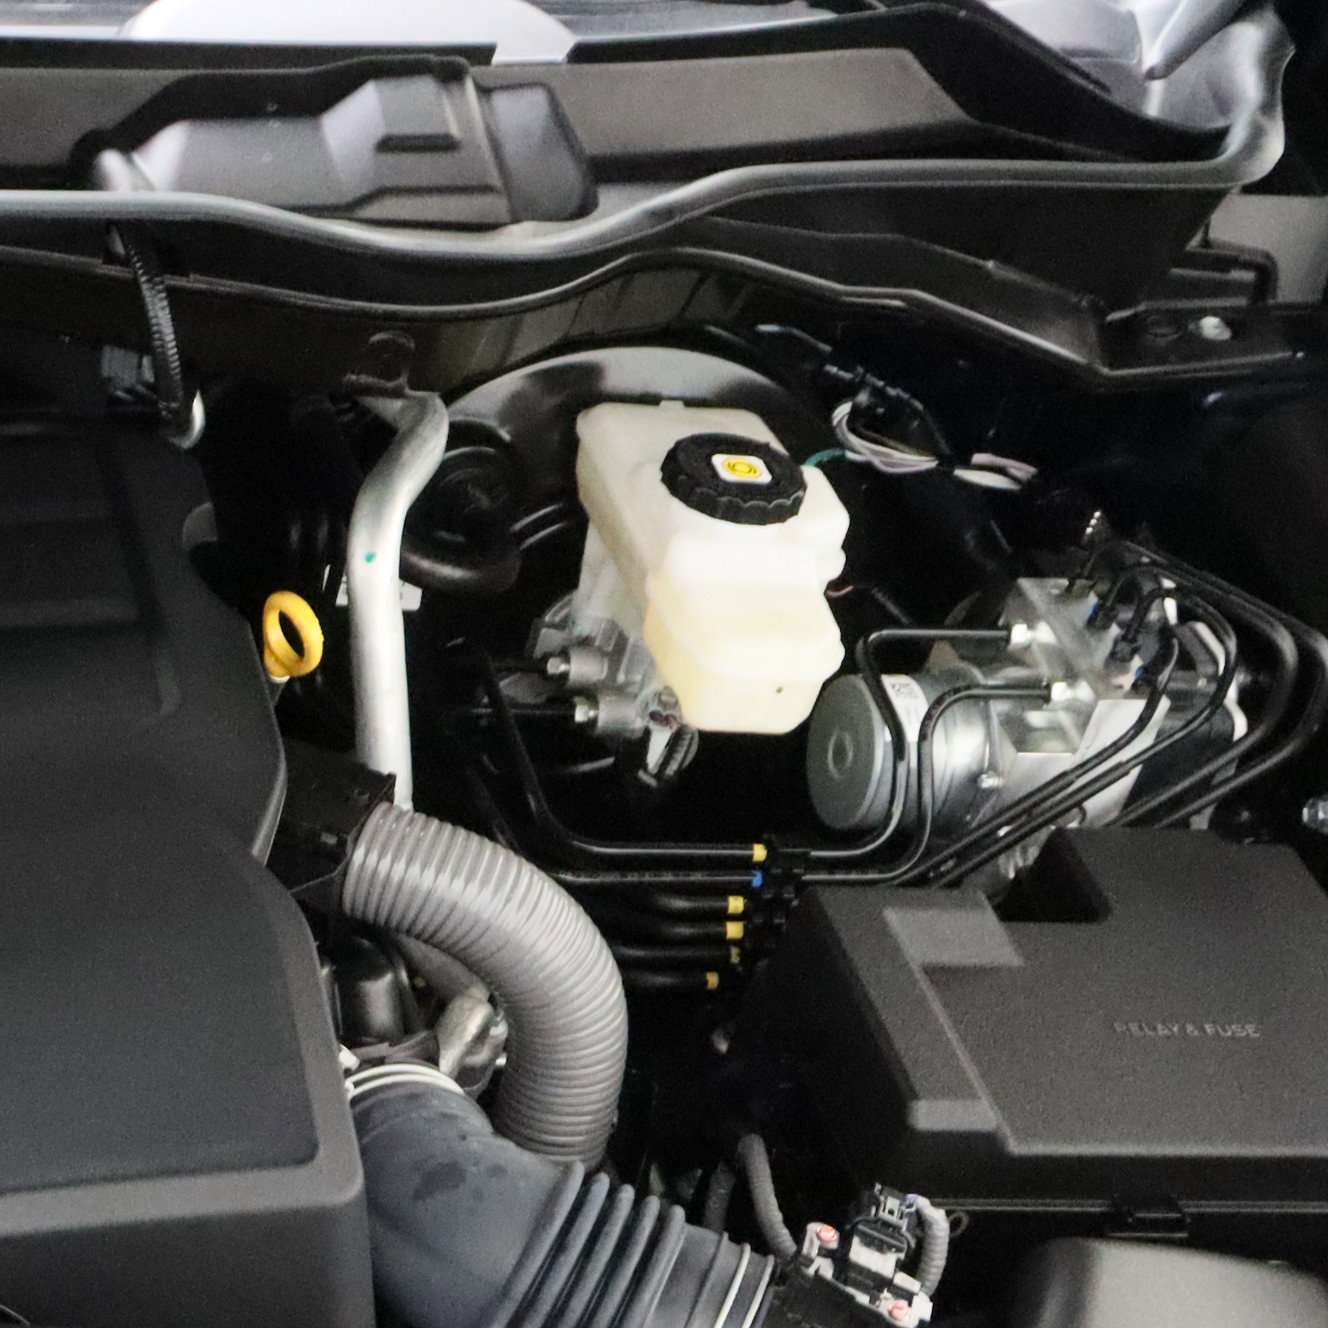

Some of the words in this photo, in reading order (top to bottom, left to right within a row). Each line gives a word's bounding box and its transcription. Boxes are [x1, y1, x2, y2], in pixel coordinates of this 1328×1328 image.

[1113, 1022, 1179, 1037] RELAY
[1185, 1023, 1199, 1038] &
[1203, 1023, 1261, 1039] FUSE
